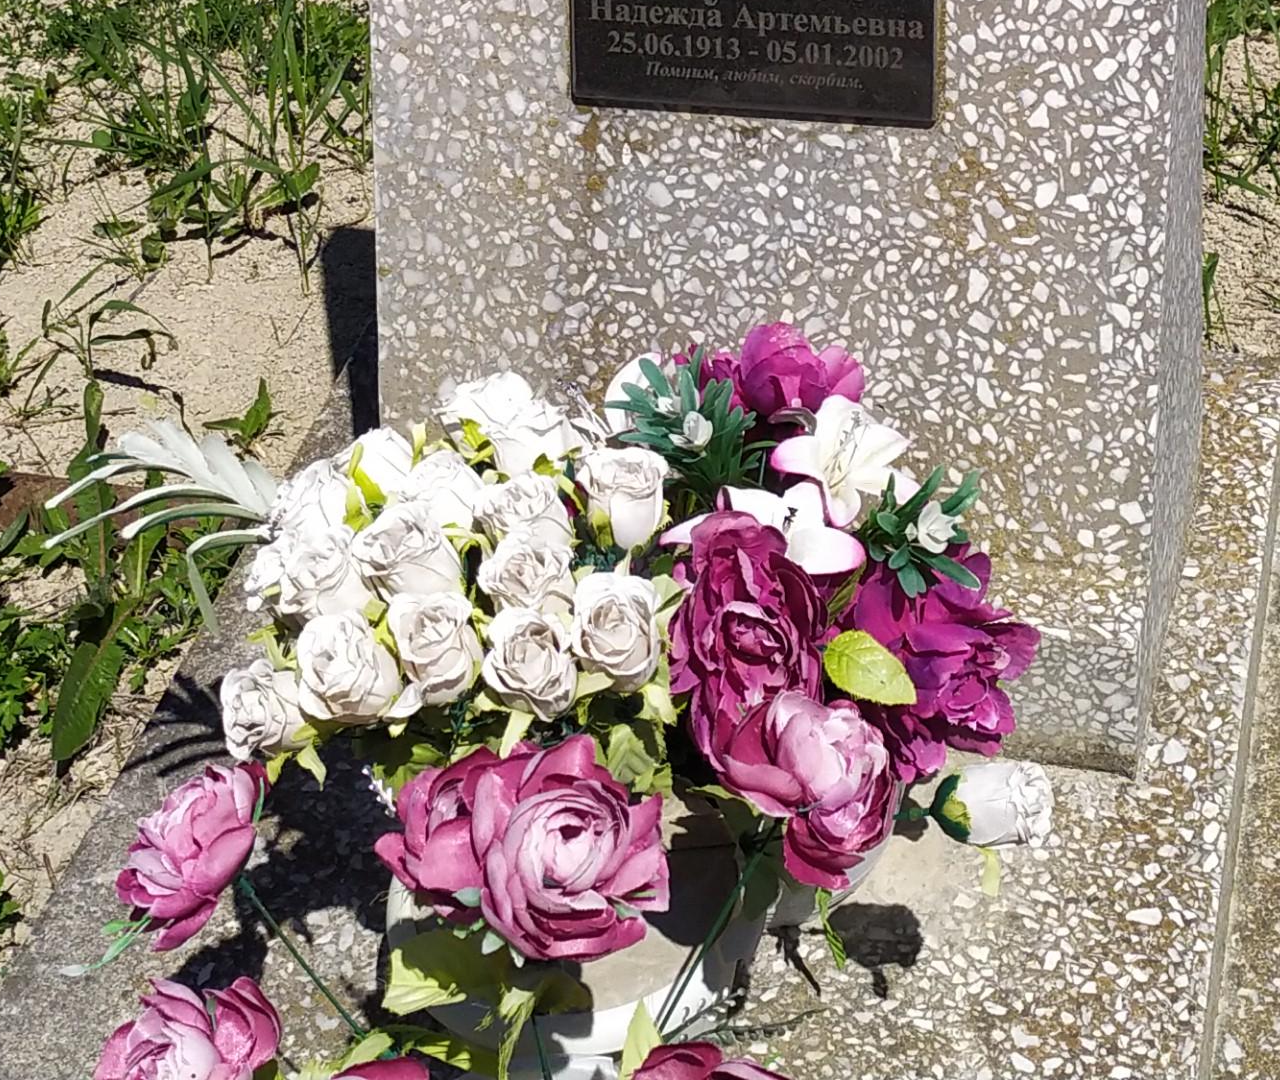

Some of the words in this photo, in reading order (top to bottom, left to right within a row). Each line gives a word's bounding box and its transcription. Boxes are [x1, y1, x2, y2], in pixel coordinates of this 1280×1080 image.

[732, 3, 926, 40] Артемьевна
[608, 30, 741, 61] 25.06.1913
[767, 40, 904, 69] 05.01.2002
[646, 61, 719, 82] Помним,
[722, 68, 785, 87] любим,
[789, 71, 864, 91] скорбим.
